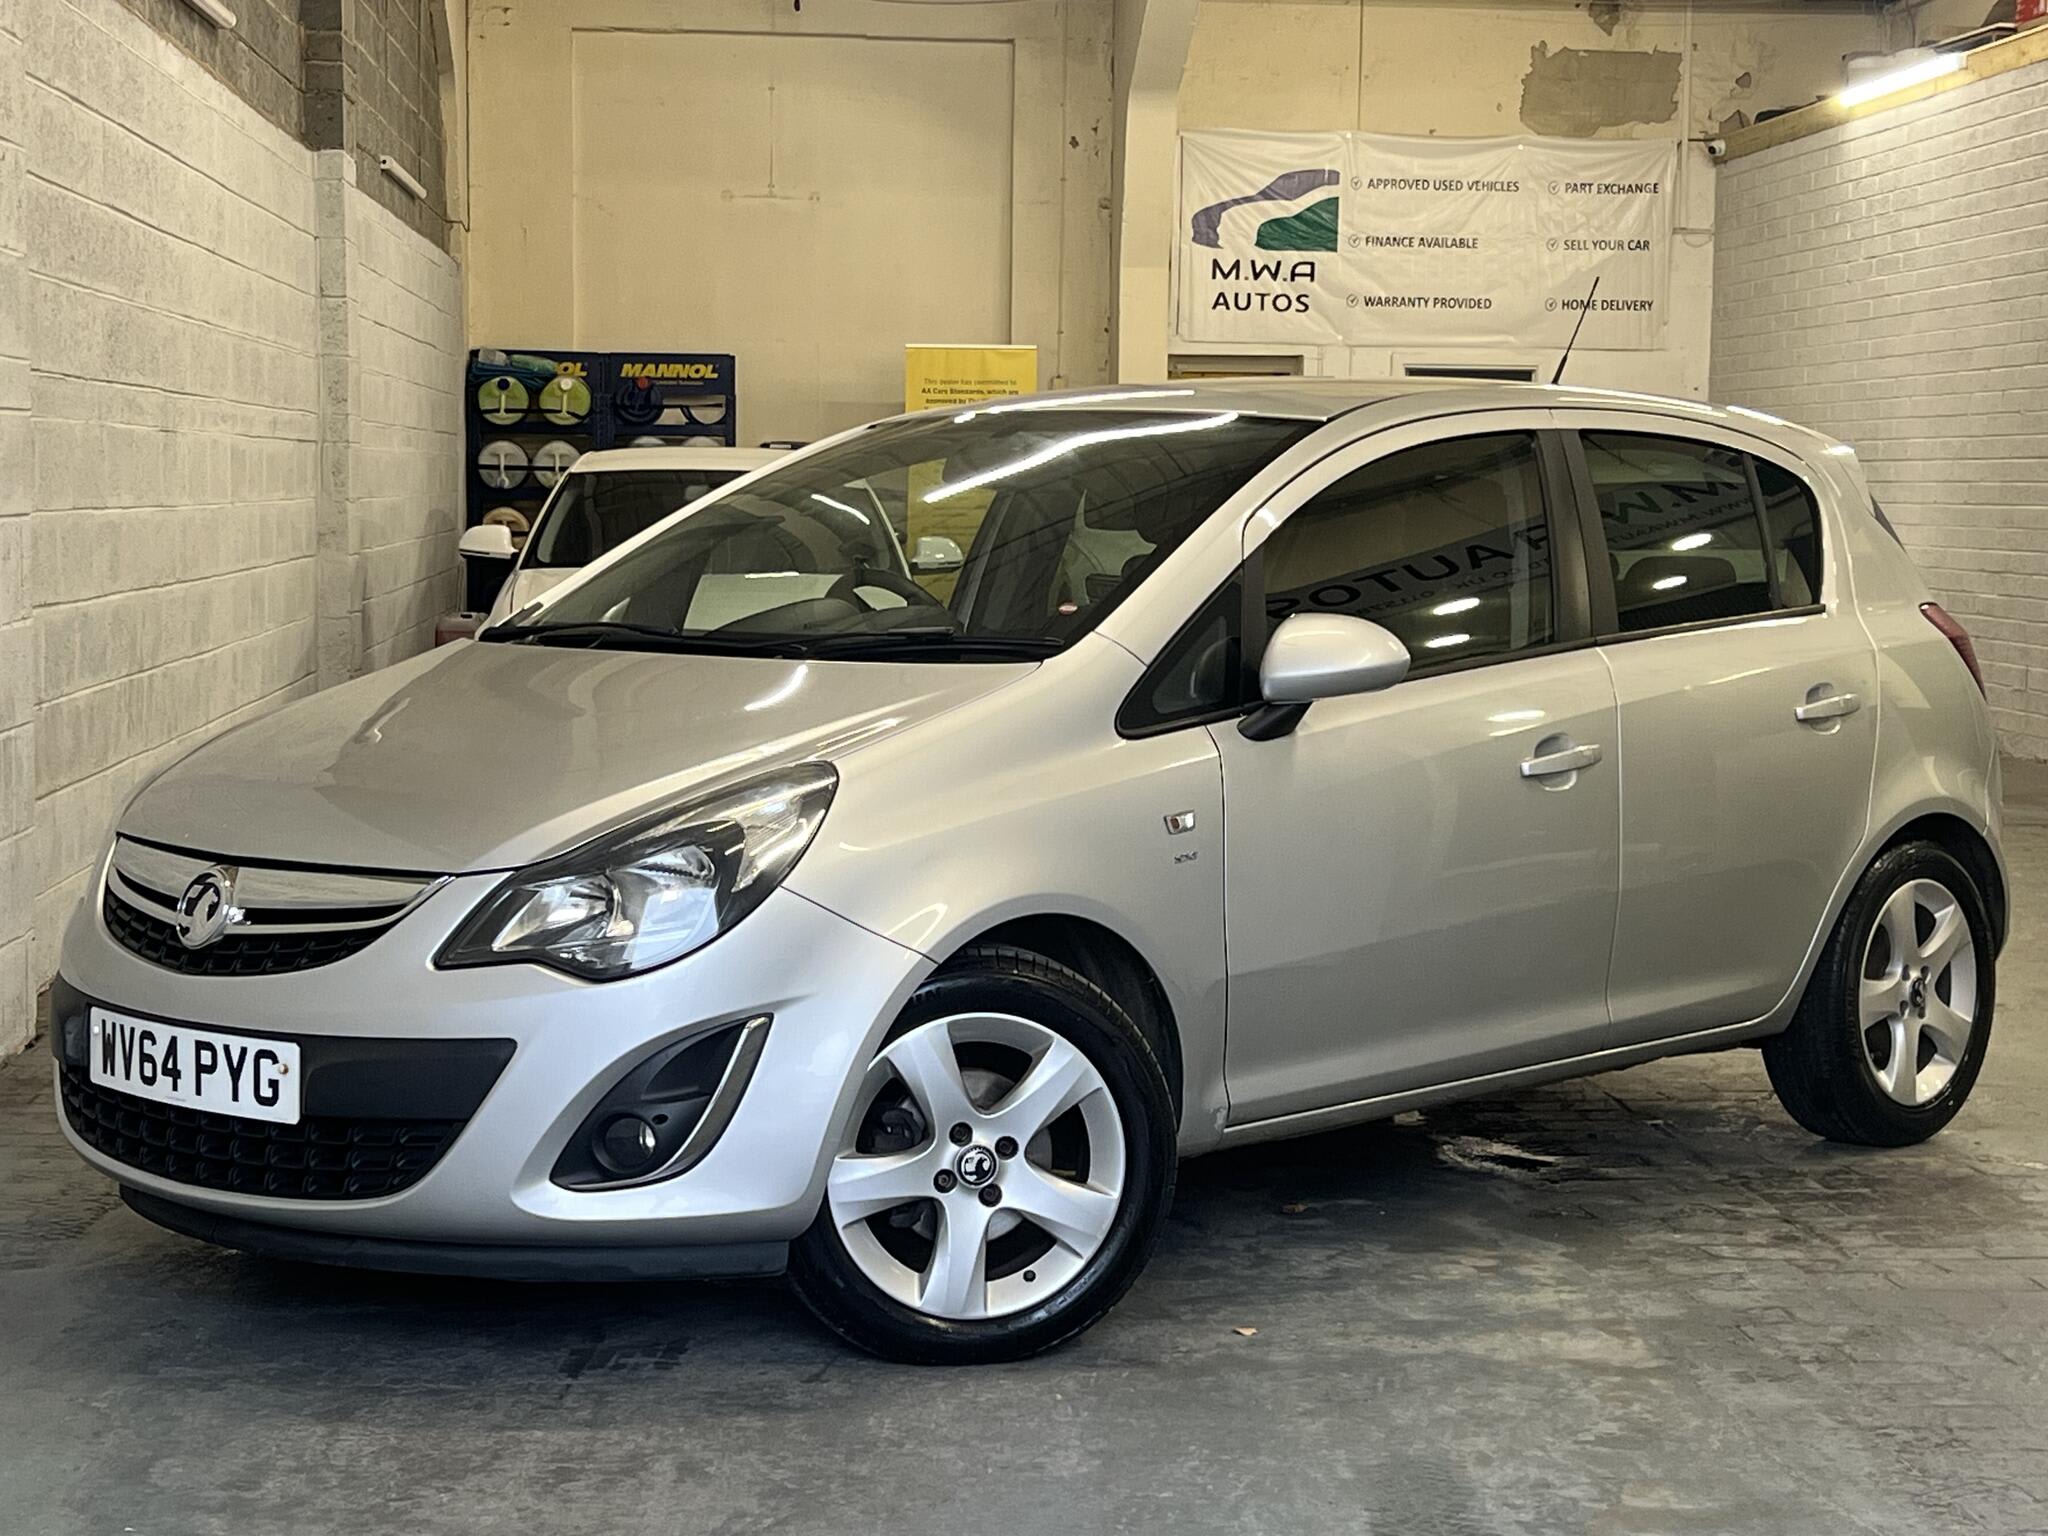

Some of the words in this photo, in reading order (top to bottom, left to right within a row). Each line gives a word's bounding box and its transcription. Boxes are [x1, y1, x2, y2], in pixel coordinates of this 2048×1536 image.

[1367, 178, 1430, 191] APPROVED
[1433, 179, 1463, 192] USED
[1467, 180, 1520, 193] VEHICLES
[1565, 182, 1594, 194] PART
[1596, 183, 1660, 195] EXCHANGE
[1365, 235, 1415, 248] FINANCE
[1418, 236, 1479, 249] AVAILABLE
[1563, 239, 1589, 251] SELL
[1592, 240, 1625, 251] YOUR
[1627, 239, 1650, 251] CAR
[1211, 258, 1316, 283] M.W.A
[1211, 291, 1310, 313] AUTOS
[1363, 295, 1431, 308] WARRANTY
[1433, 297, 1493, 310] PROVIDED
[1561, 299, 1597, 311] HOME
[1601, 299, 1654, 312] DELIVERY
[620, 363, 719, 379] MANNOL
[101, 1018, 182, 1092] WV64
[194, 1039, 281, 1107] PYG
